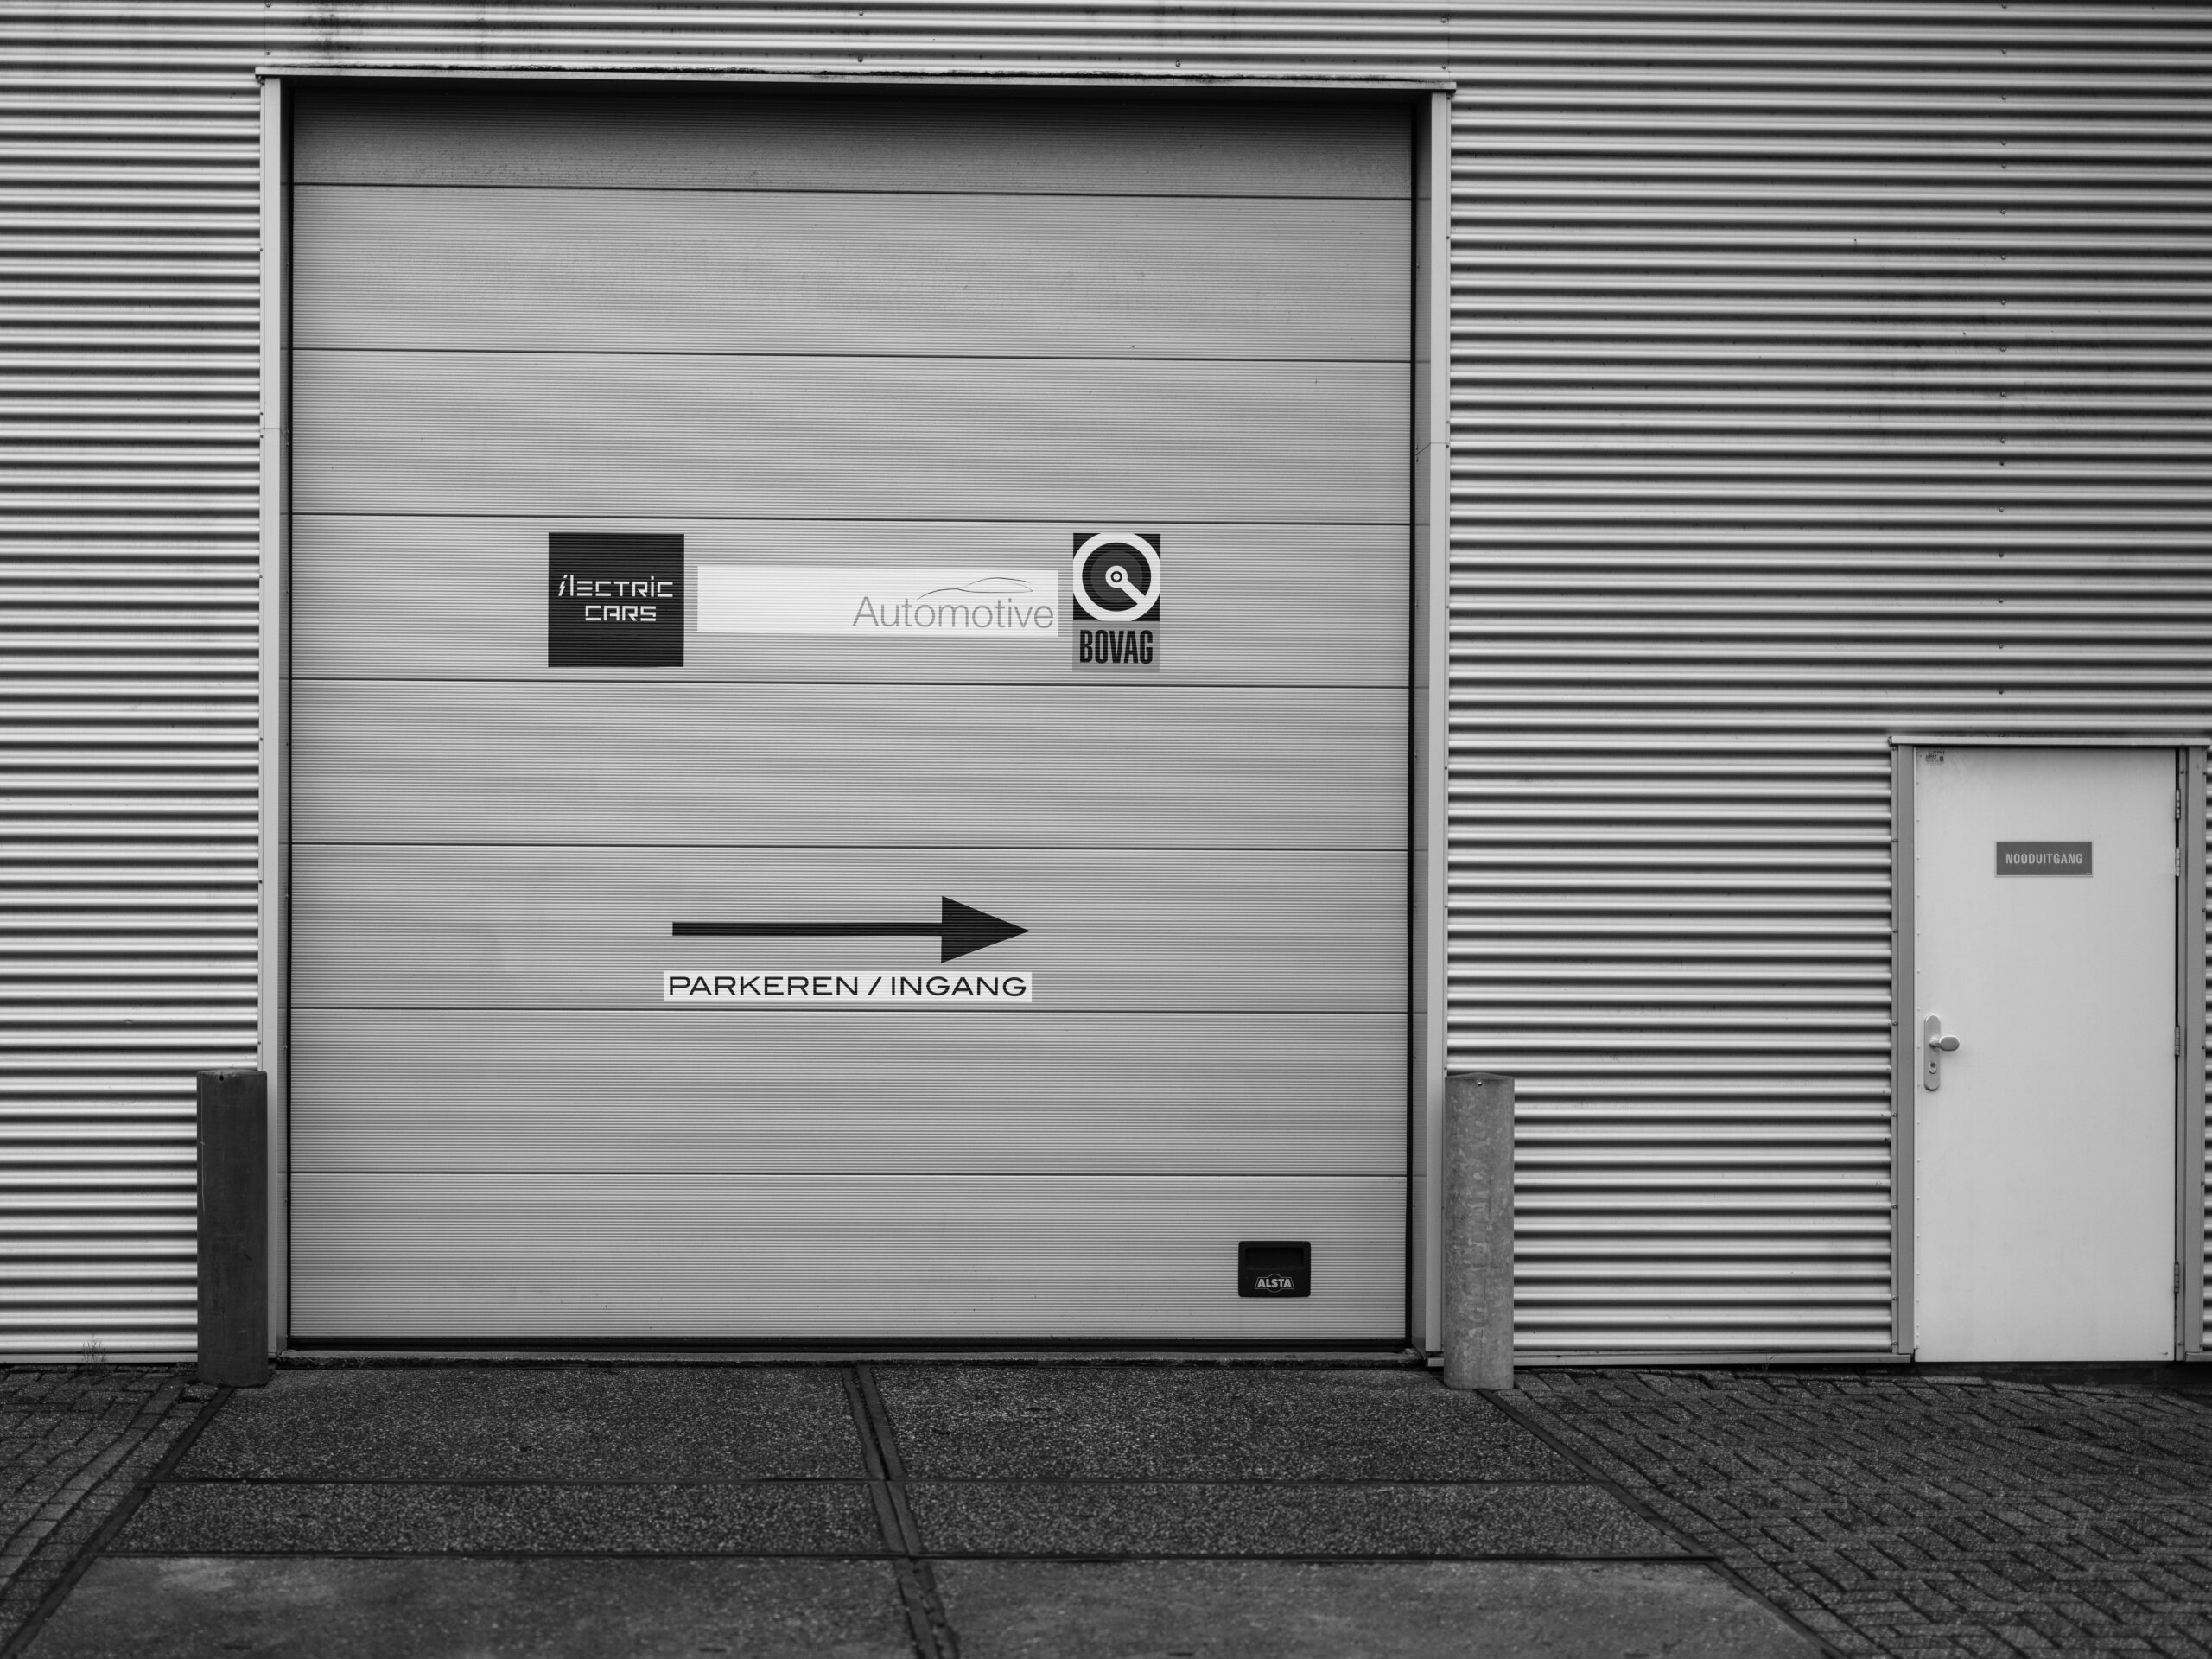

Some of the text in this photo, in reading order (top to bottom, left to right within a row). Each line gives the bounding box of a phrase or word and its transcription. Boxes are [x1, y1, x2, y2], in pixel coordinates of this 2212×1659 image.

[585, 605, 657, 621] CARS
[852, 596, 1054, 628] Automotive
[1079, 629, 1154, 664] BOVAG
[2005, 853, 2083, 864] NOODUITGANG
[1257, 1278, 1292, 1288] ALSTA
